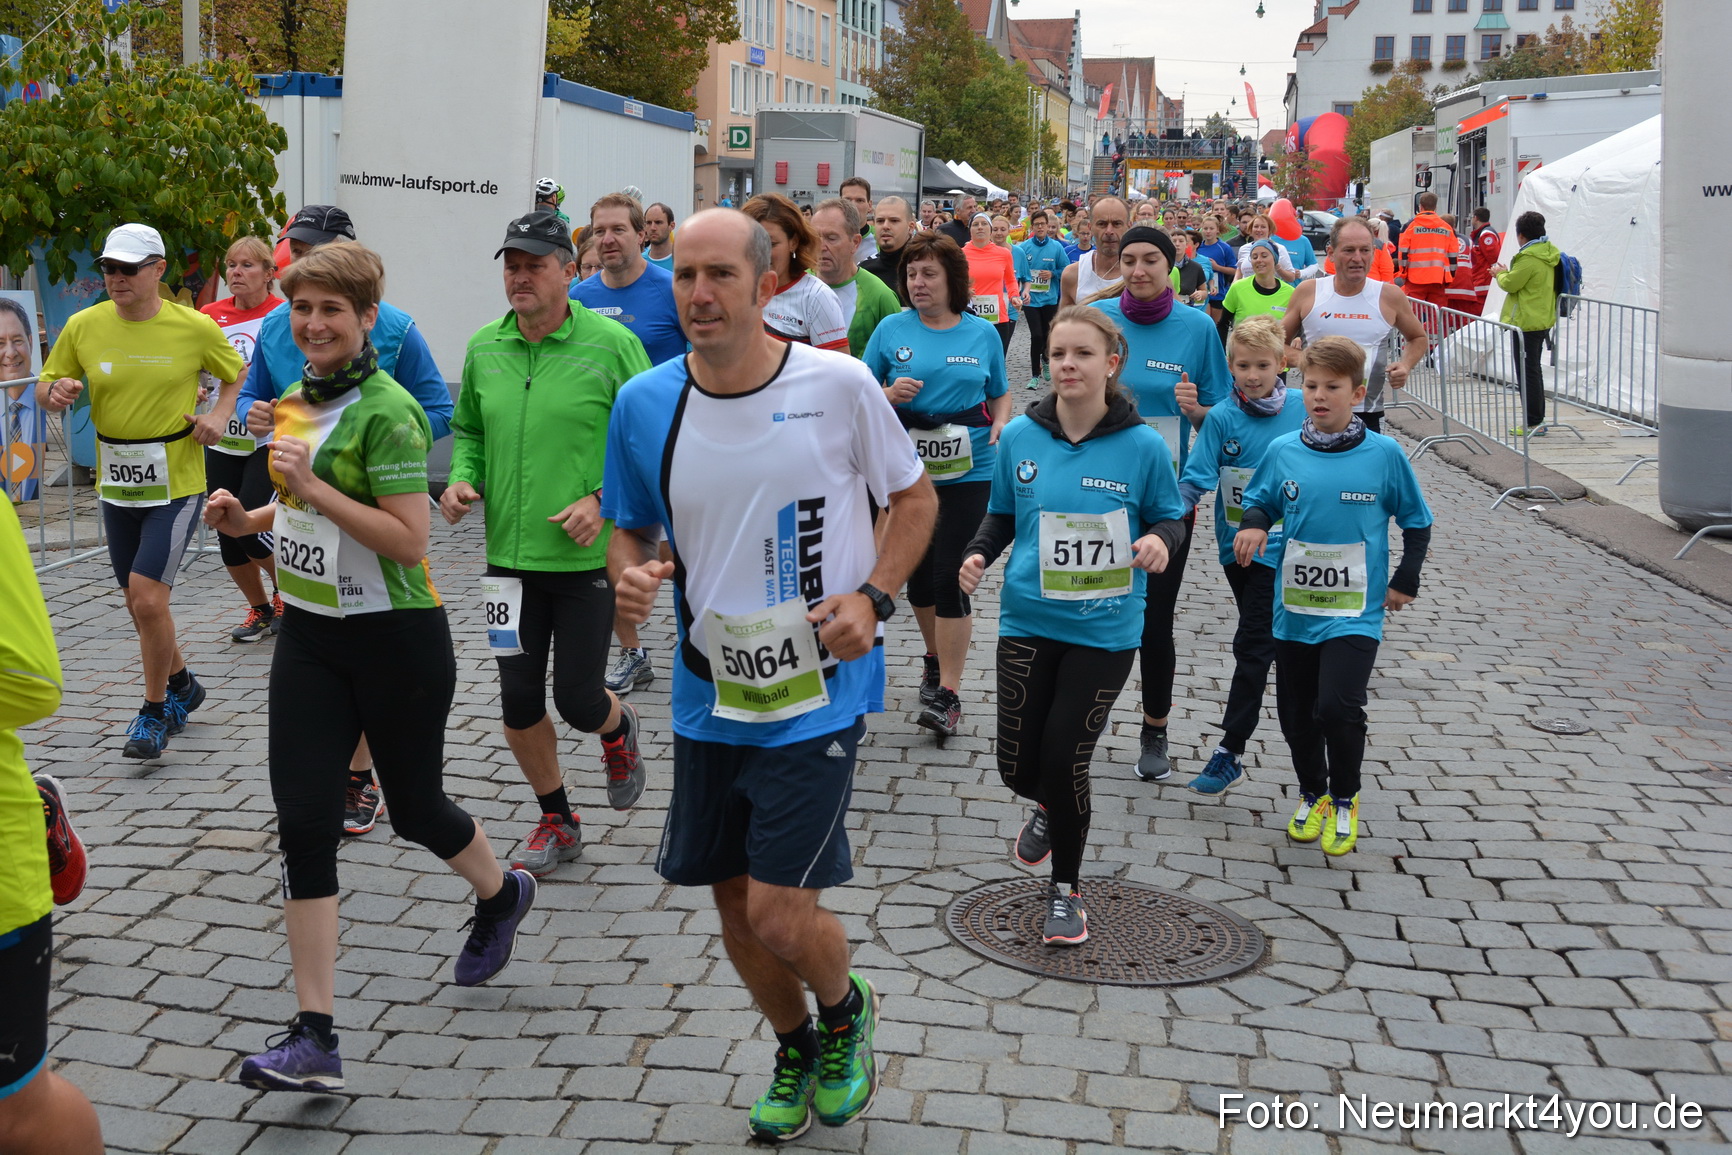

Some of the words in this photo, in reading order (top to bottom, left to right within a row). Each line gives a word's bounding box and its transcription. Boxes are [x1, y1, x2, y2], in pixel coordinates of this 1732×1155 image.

[732, 129, 748, 146] D
[1165, 160, 1186, 169] ZIEL
[339, 171, 499, 195] www.bmw-laufsport.de
[1702, 184, 1732, 198] ww
[1416, 227, 1448, 236] NOTARZT
[972, 303, 995, 314] 5150
[768, 313, 797, 324] NEUMARKT
[946, 355, 980, 366] BOCK
[1146, 359, 1184, 373] BOCK
[224, 419, 248, 437] 60
[916, 436, 962, 459] 5057
[109, 463, 157, 484] 5054
[121, 489, 145, 497] Rainer
[1081, 476, 1129, 494] BOCK
[1340, 491, 1377, 502] BOCK
[280, 535, 325, 577] 5223
[764, 537, 774, 576] WASTE
[1053, 538, 1116, 566] 5171
[1071, 575, 1104, 585] Nadine
[1293, 564, 1350, 588] 5201
[1309, 594, 1337, 603] Pascal
[486, 601, 510, 625] 88
[721, 636, 800, 681] 5064
[741, 685, 790, 705] Willibald
